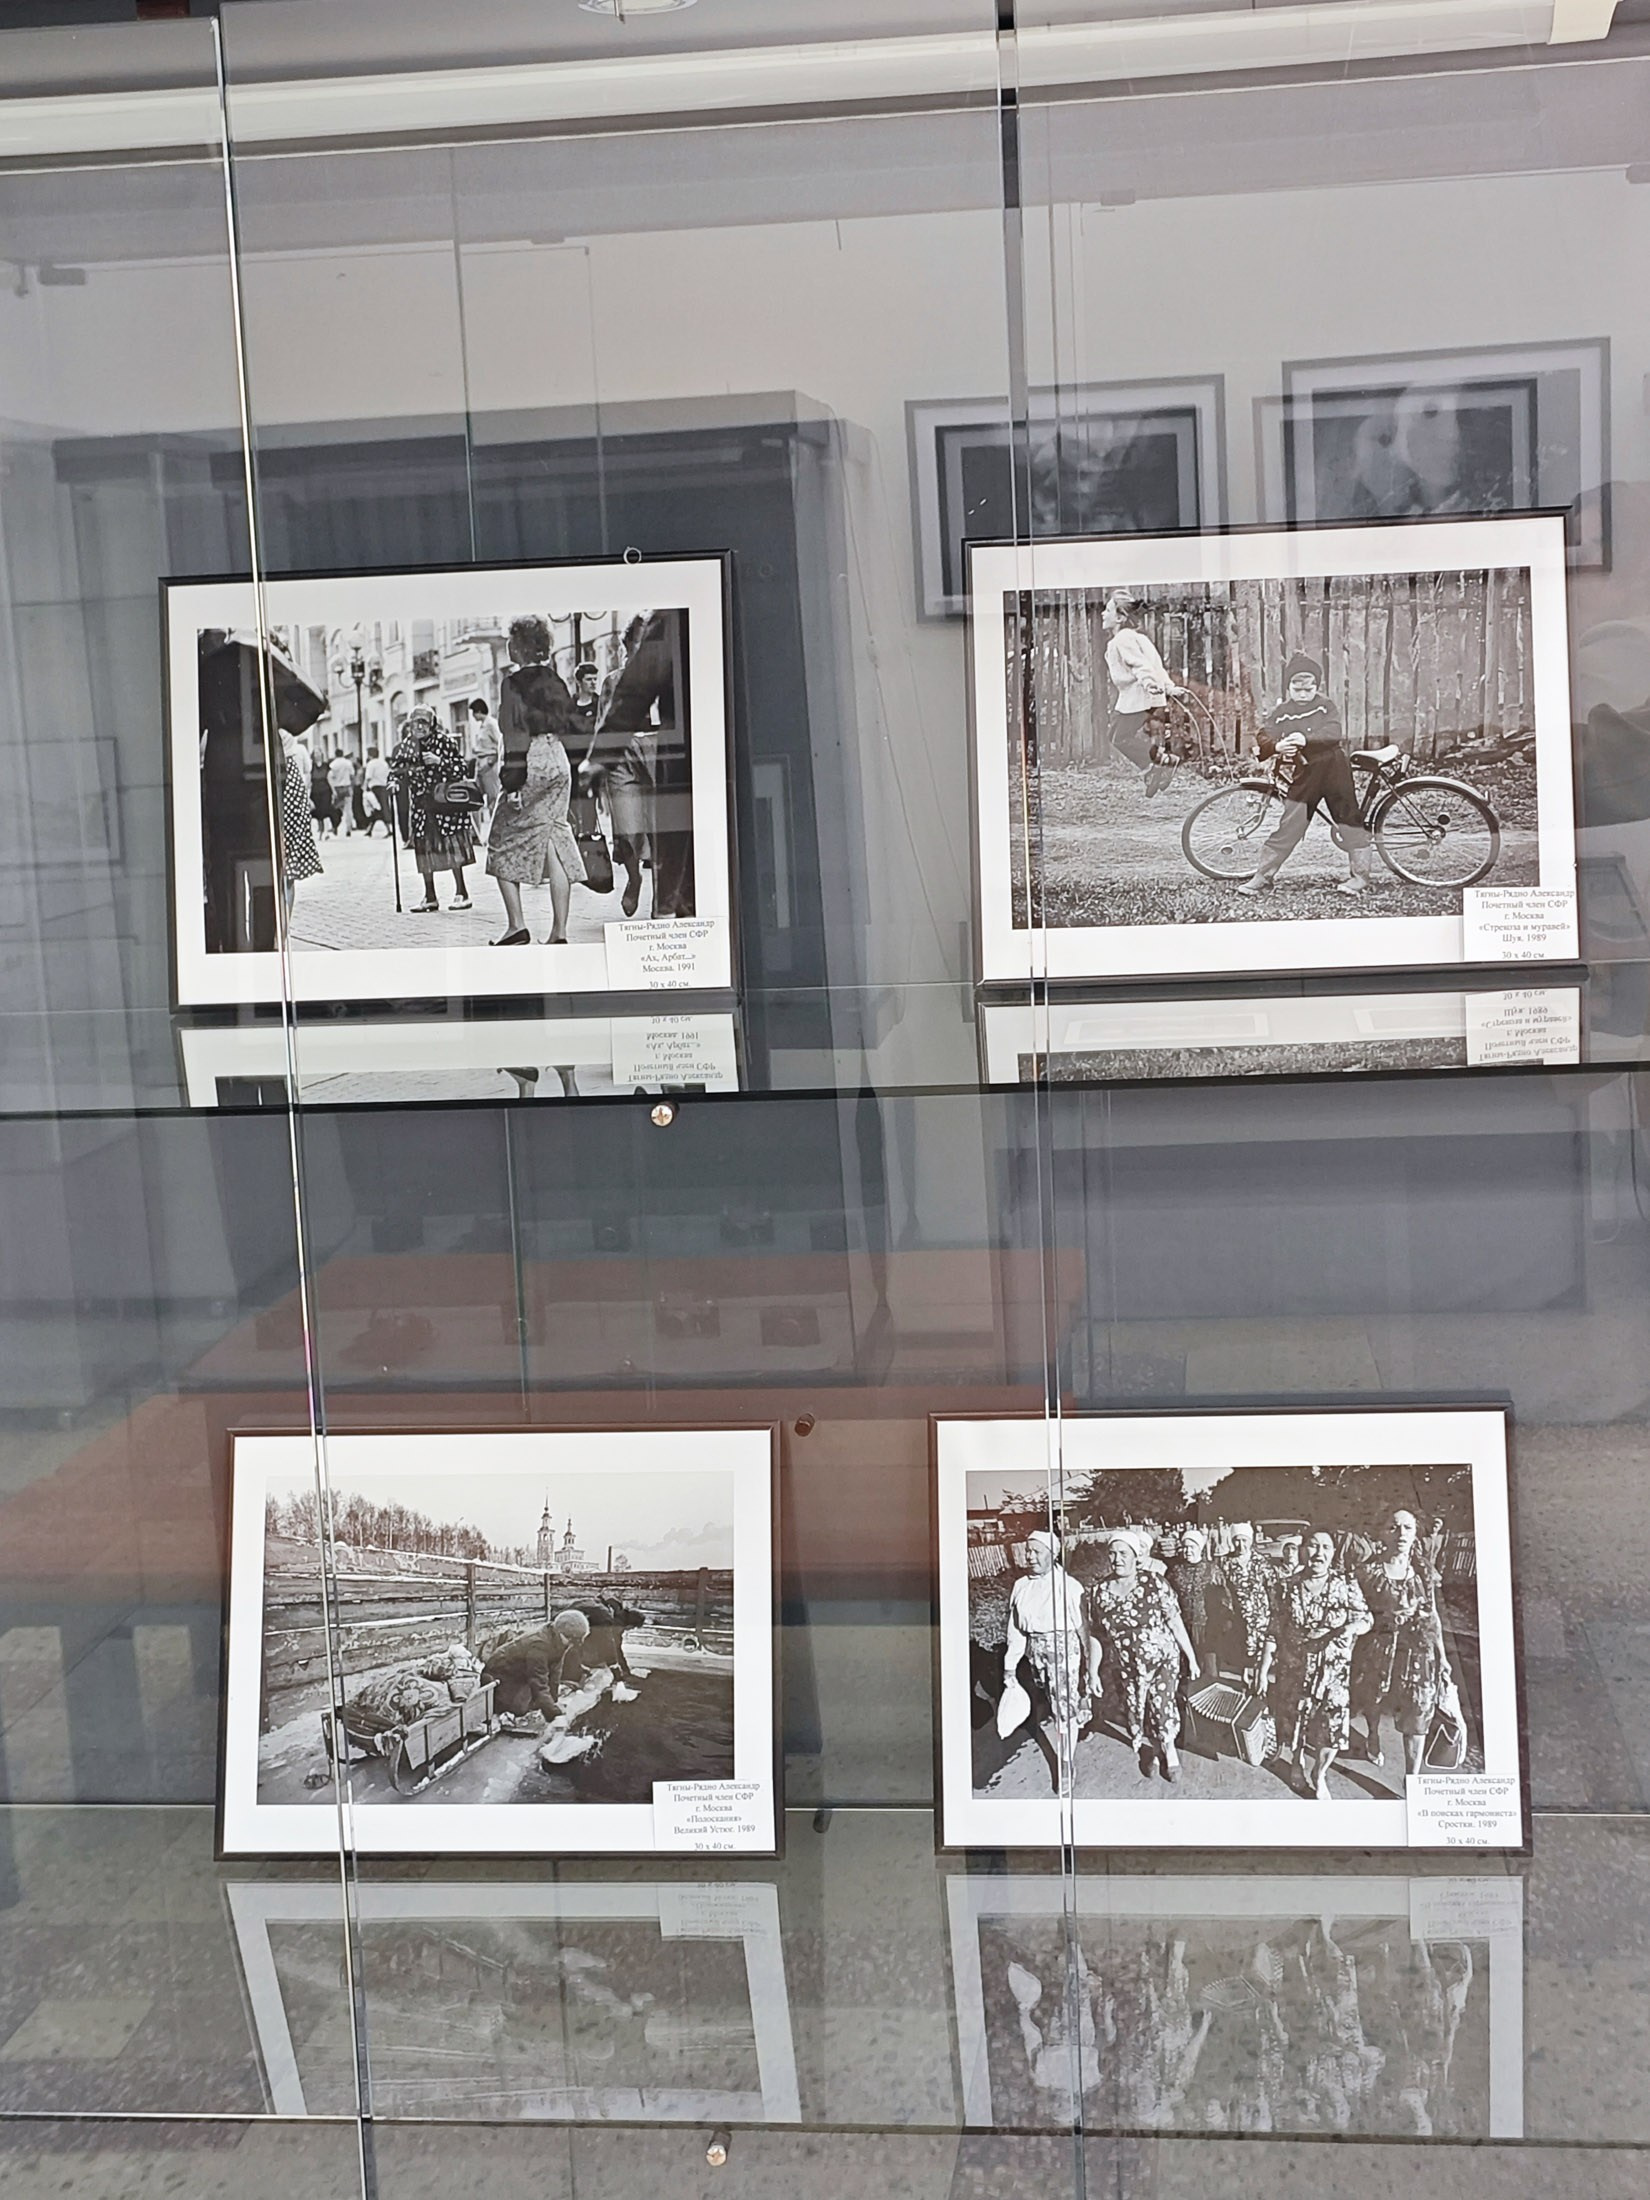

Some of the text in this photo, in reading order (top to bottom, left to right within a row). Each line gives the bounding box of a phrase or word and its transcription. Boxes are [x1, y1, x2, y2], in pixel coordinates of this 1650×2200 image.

[1530, 889, 1575, 898] Александр
[1481, 900, 1524, 909] Почетный
[1547, 900, 1568, 908] СФР
[1512, 912, 1544, 920] Москва
[672, 920, 715, 929] Александр
[1478, 923, 1521, 933] «Стрекоза
[1530, 922, 1570, 932] муравей»
[626, 932, 667, 942] Почетный
[689, 930, 709, 938] СФР
[1527, 933, 1547, 942] 1989
[657, 942, 687, 950] Москва
[1502, 951, 1512, 959] 30
[677, 962, 695, 971] 1991
[1471, 1776, 1515, 1785] Александр
[718, 1783, 760, 1791] Александр
[1424, 1787, 1466, 1795] Почетный
[1489, 1787, 1509, 1795] СФР
[674, 1794, 713, 1802] Почетный
[1455, 1798, 1487, 1806] Москва
[703, 1804, 733, 1812] Москва
[1478, 1820, 1497, 1828] 1989
[674, 1826, 708, 1834] Великий
[737, 1825, 756, 1833] 1989
[1446, 1837, 1456, 1845] 30
[1465, 1837, 1475, 1845] 40
